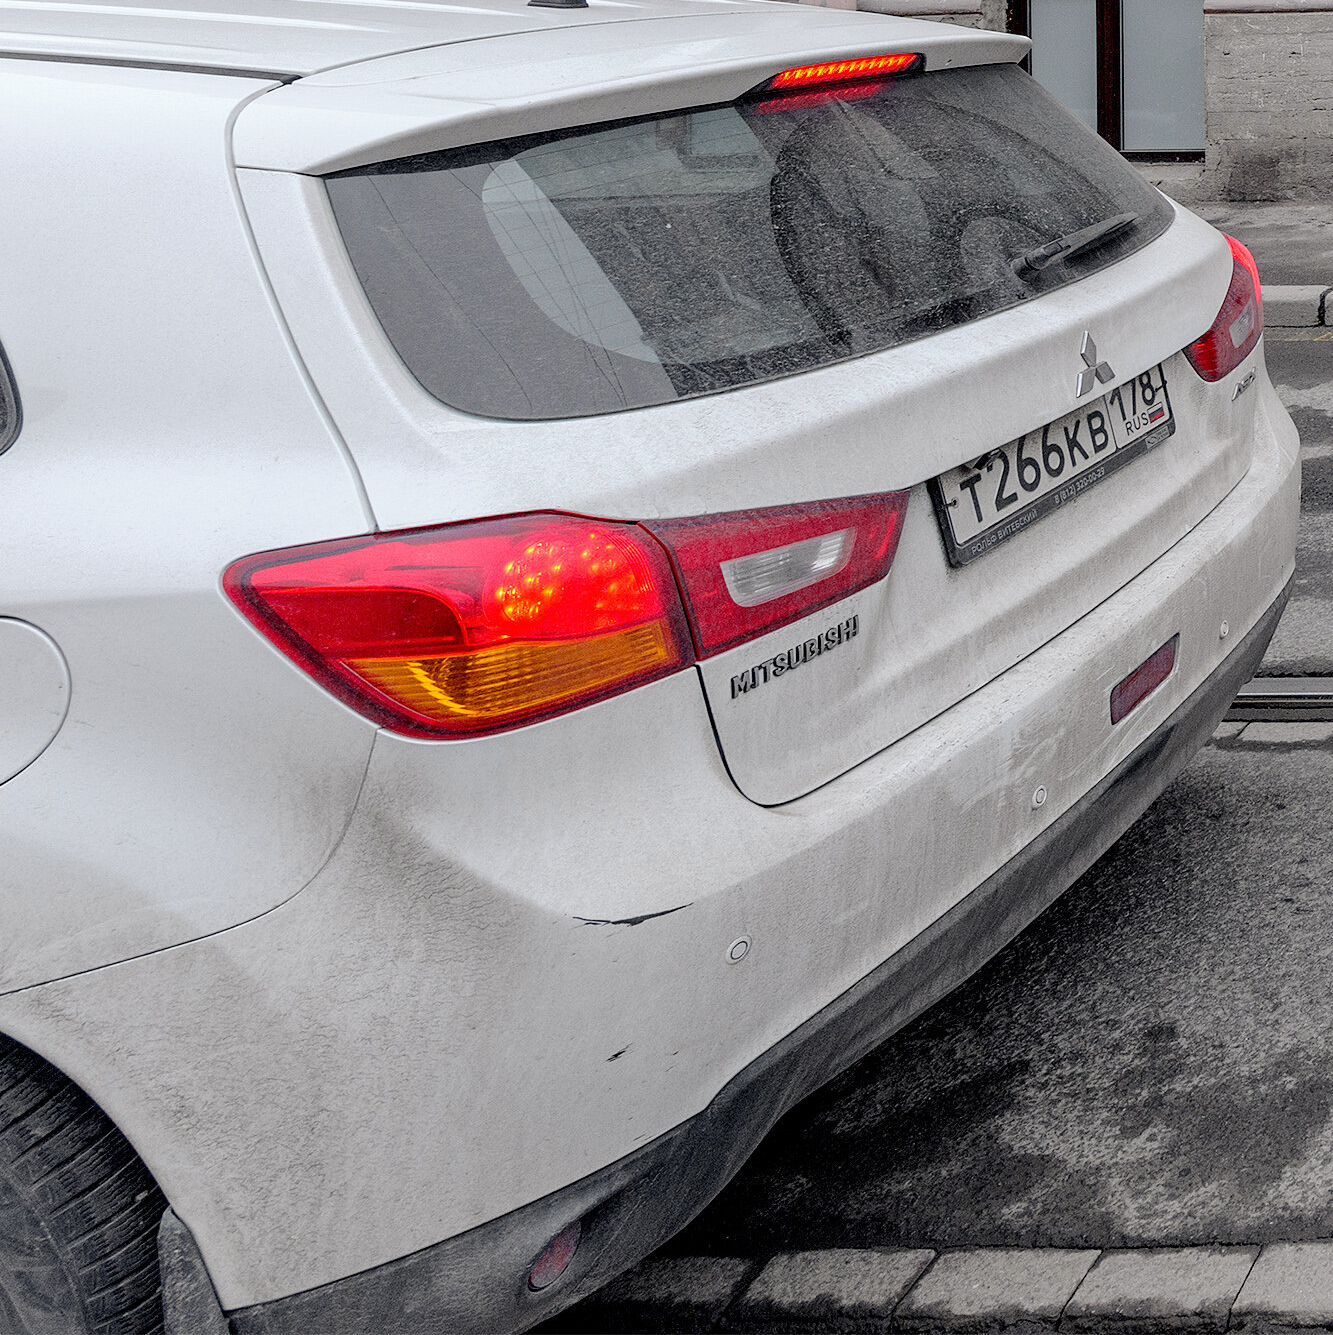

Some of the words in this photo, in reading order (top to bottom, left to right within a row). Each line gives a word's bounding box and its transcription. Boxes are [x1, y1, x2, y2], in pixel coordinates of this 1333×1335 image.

[1109, 370, 1157, 422] 178
[1125, 412, 1149, 436] RUS
[1054, 496, 1060, 504] 8
[1060, 484, 1077, 502] (812)
[971, 535, 998, 556] РОЛЬФ
[997, 508, 1038, 540] ВИТЕБСКИЙ
[730, 614, 860, 699] MITSUBISHI
